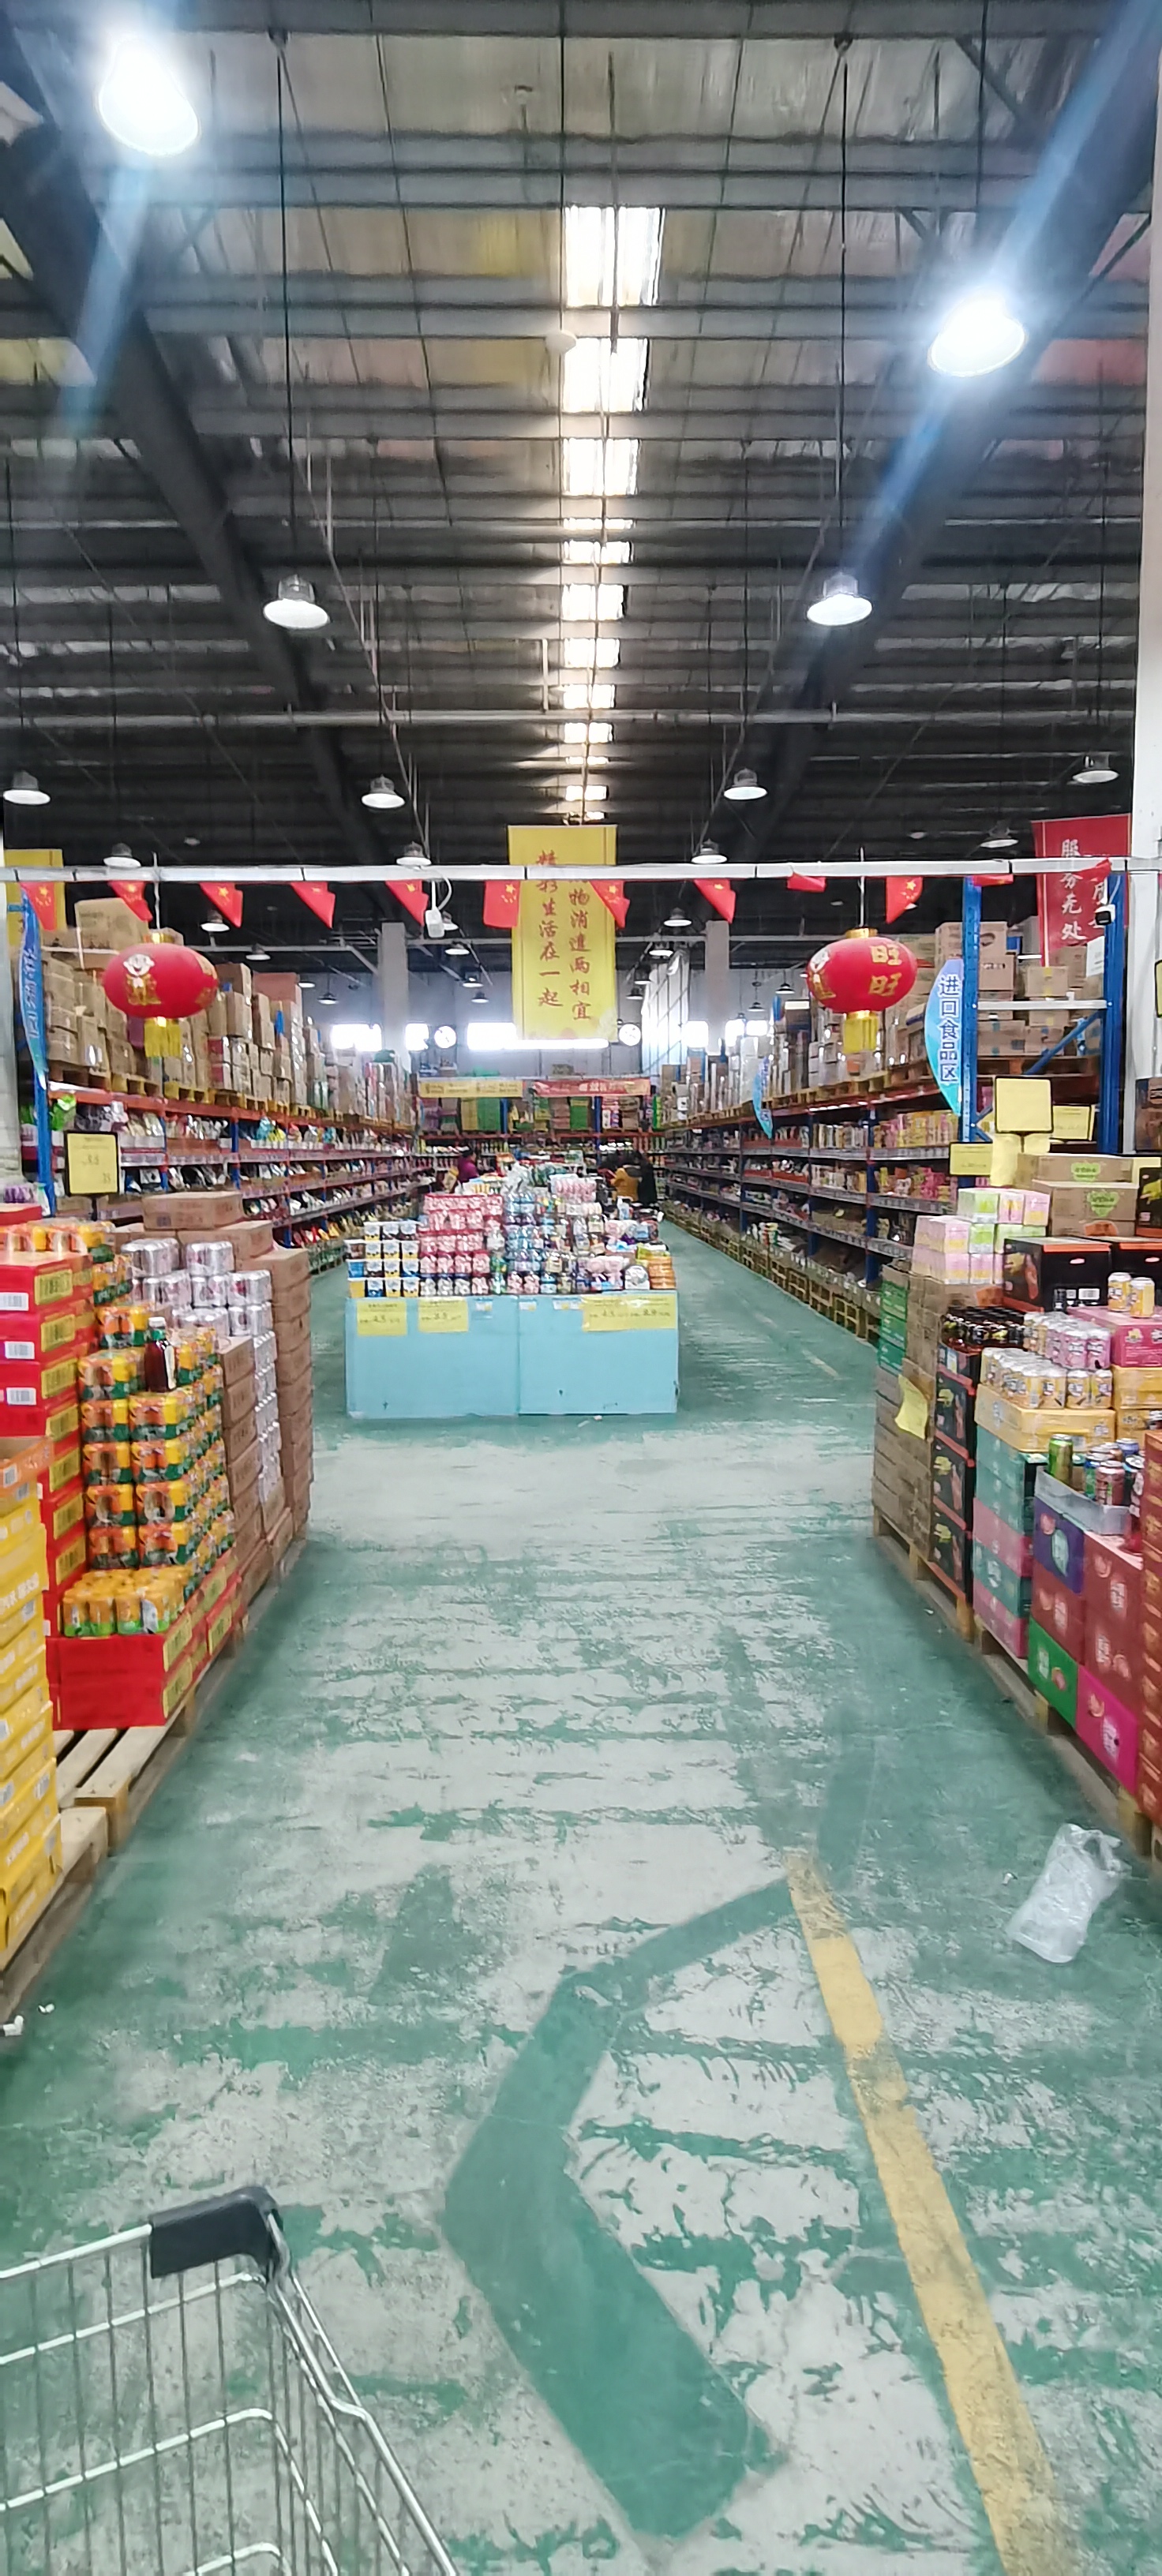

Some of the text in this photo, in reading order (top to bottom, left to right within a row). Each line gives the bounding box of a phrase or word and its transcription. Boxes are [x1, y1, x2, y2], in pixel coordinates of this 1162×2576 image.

[568, 880, 591, 1020] 物消遣两相宜
[868, 943, 903, 998] 旺旺
[938, 974, 961, 1084] 进口食品区
